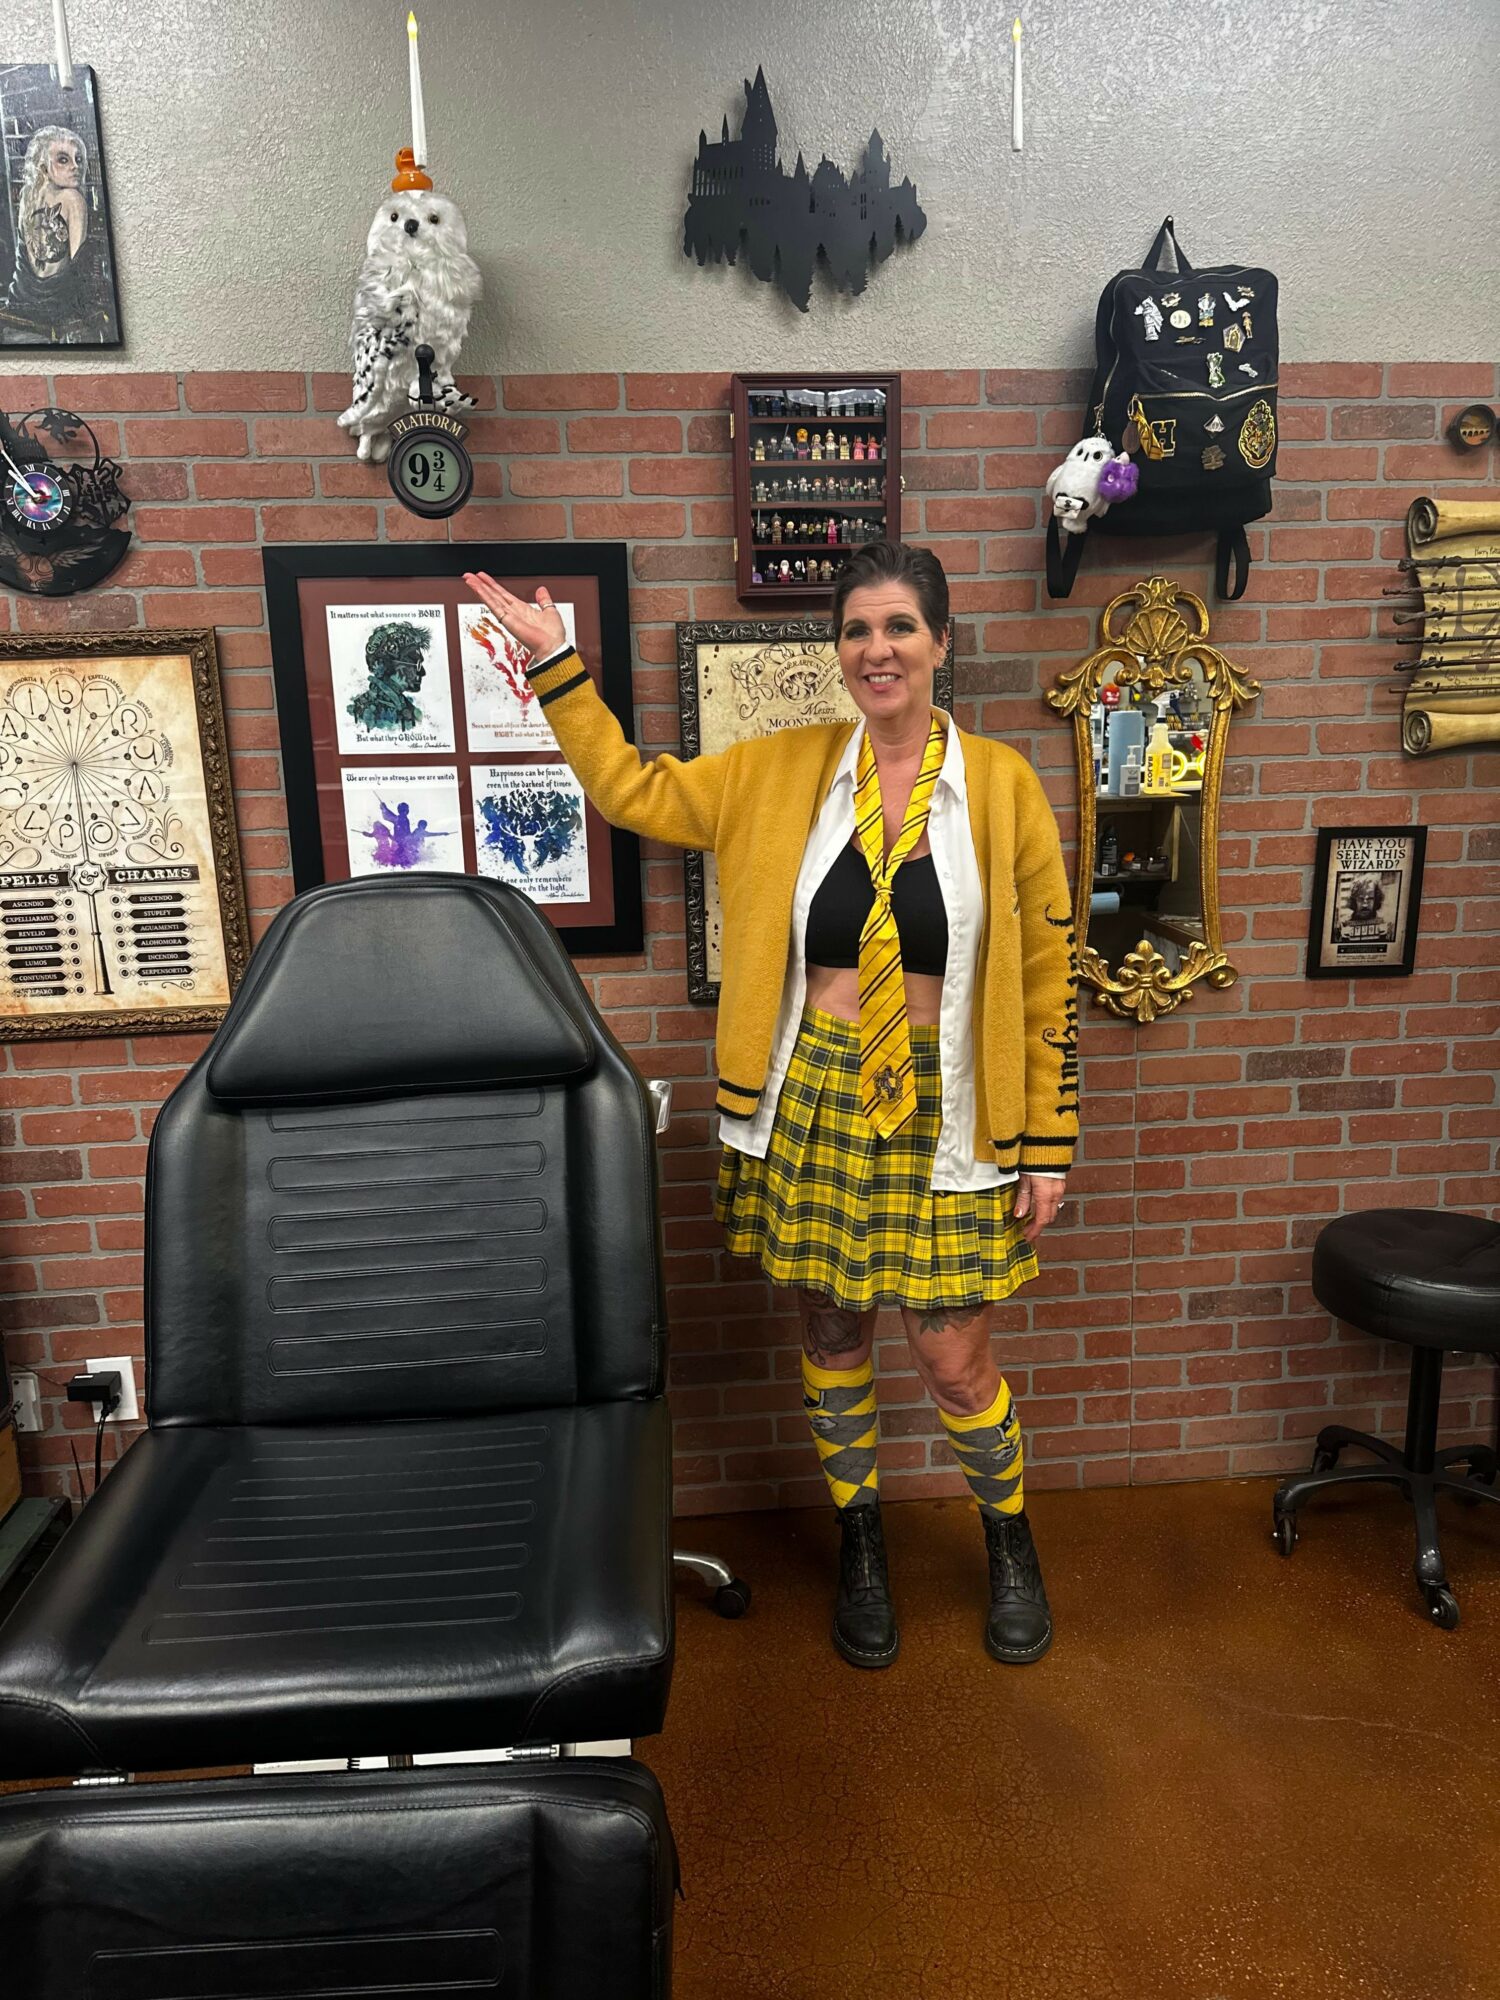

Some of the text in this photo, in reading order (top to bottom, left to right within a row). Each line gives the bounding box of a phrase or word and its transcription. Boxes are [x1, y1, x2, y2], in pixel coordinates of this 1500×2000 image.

[393, 413, 463, 436] PLATFORM
[330, 610, 336, 618] It
[418, 610, 441, 618] BORN
[356, 734, 368, 742] But
[398, 733, 422, 742] GROW
[346, 774, 357, 782] We
[369, 774, 381, 785] only
[389, 774, 409, 782] strong
[489, 768, 524, 782] Happiness
[546, 768, 566, 779] found,
[510, 780, 520, 788] the
[521, 780, 544, 788] darkest
[546, 779, 552, 790] of
[1337, 838, 1407, 849] HAVE YOU
[1336, 849, 1406, 860] SEEN THIS
[1341, 859, 1400, 870] WIZARD?
[0, 874, 60, 888] PELLS
[115, 868, 192, 882] CHARMS
[519, 876, 533, 886] only
[535, 874, 572, 882] remembers
[550, 884, 568, 893] light.
[142, 968, 188, 976] SERPENSORTIA
